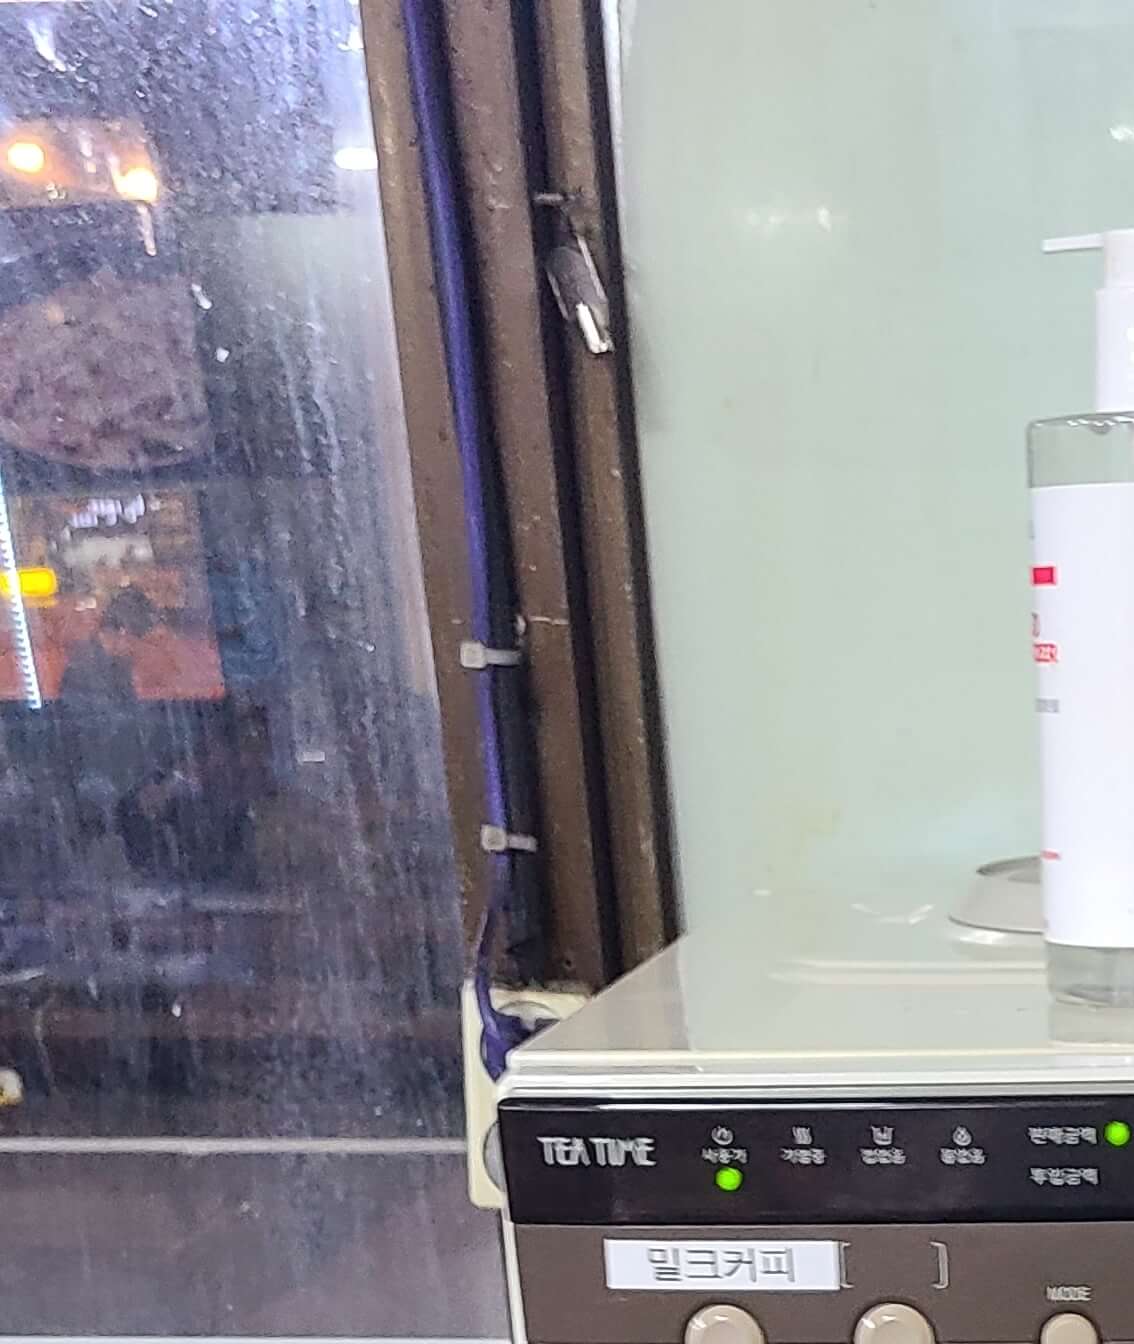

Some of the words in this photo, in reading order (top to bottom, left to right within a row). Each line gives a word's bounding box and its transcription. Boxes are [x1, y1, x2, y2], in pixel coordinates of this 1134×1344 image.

[537, 1136, 591, 1166] TEA
[595, 1138, 657, 1167] TIME
[647, 1246, 795, 1283] 밀크커피
[1046, 1286, 1092, 1301] MODE
